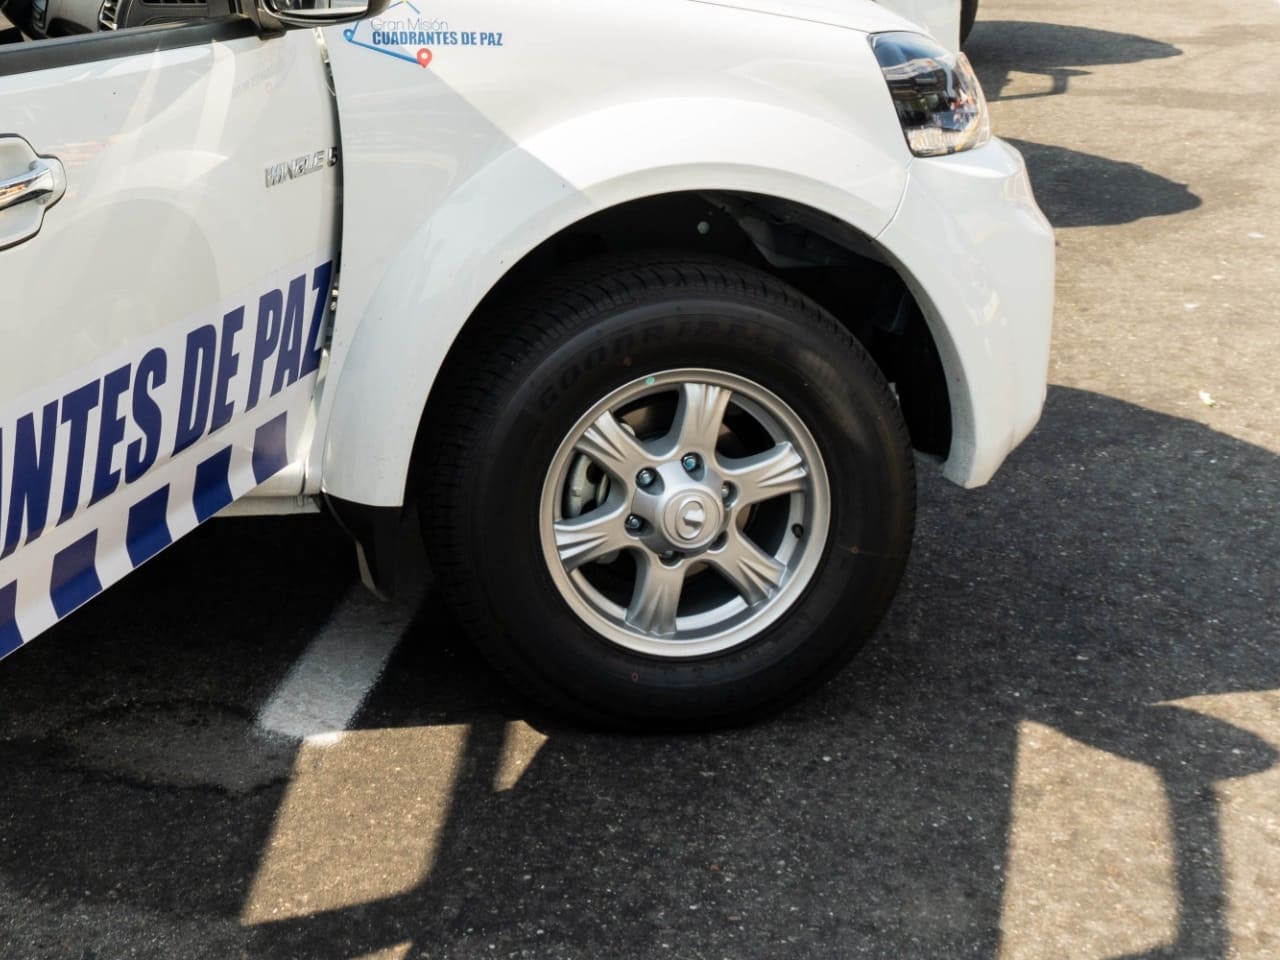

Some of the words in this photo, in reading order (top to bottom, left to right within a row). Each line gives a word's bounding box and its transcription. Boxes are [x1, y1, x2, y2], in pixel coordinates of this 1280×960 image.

[370, 18, 406, 31] Gran
[407, 18, 448, 31] Misión
[372, 31, 458, 46] CUADRANTES
[460, 31, 478, 46] DE
[479, 32, 503, 47] PAZ
[171, 305, 245, 457] DE
[245, 261, 333, 413] PAZ
